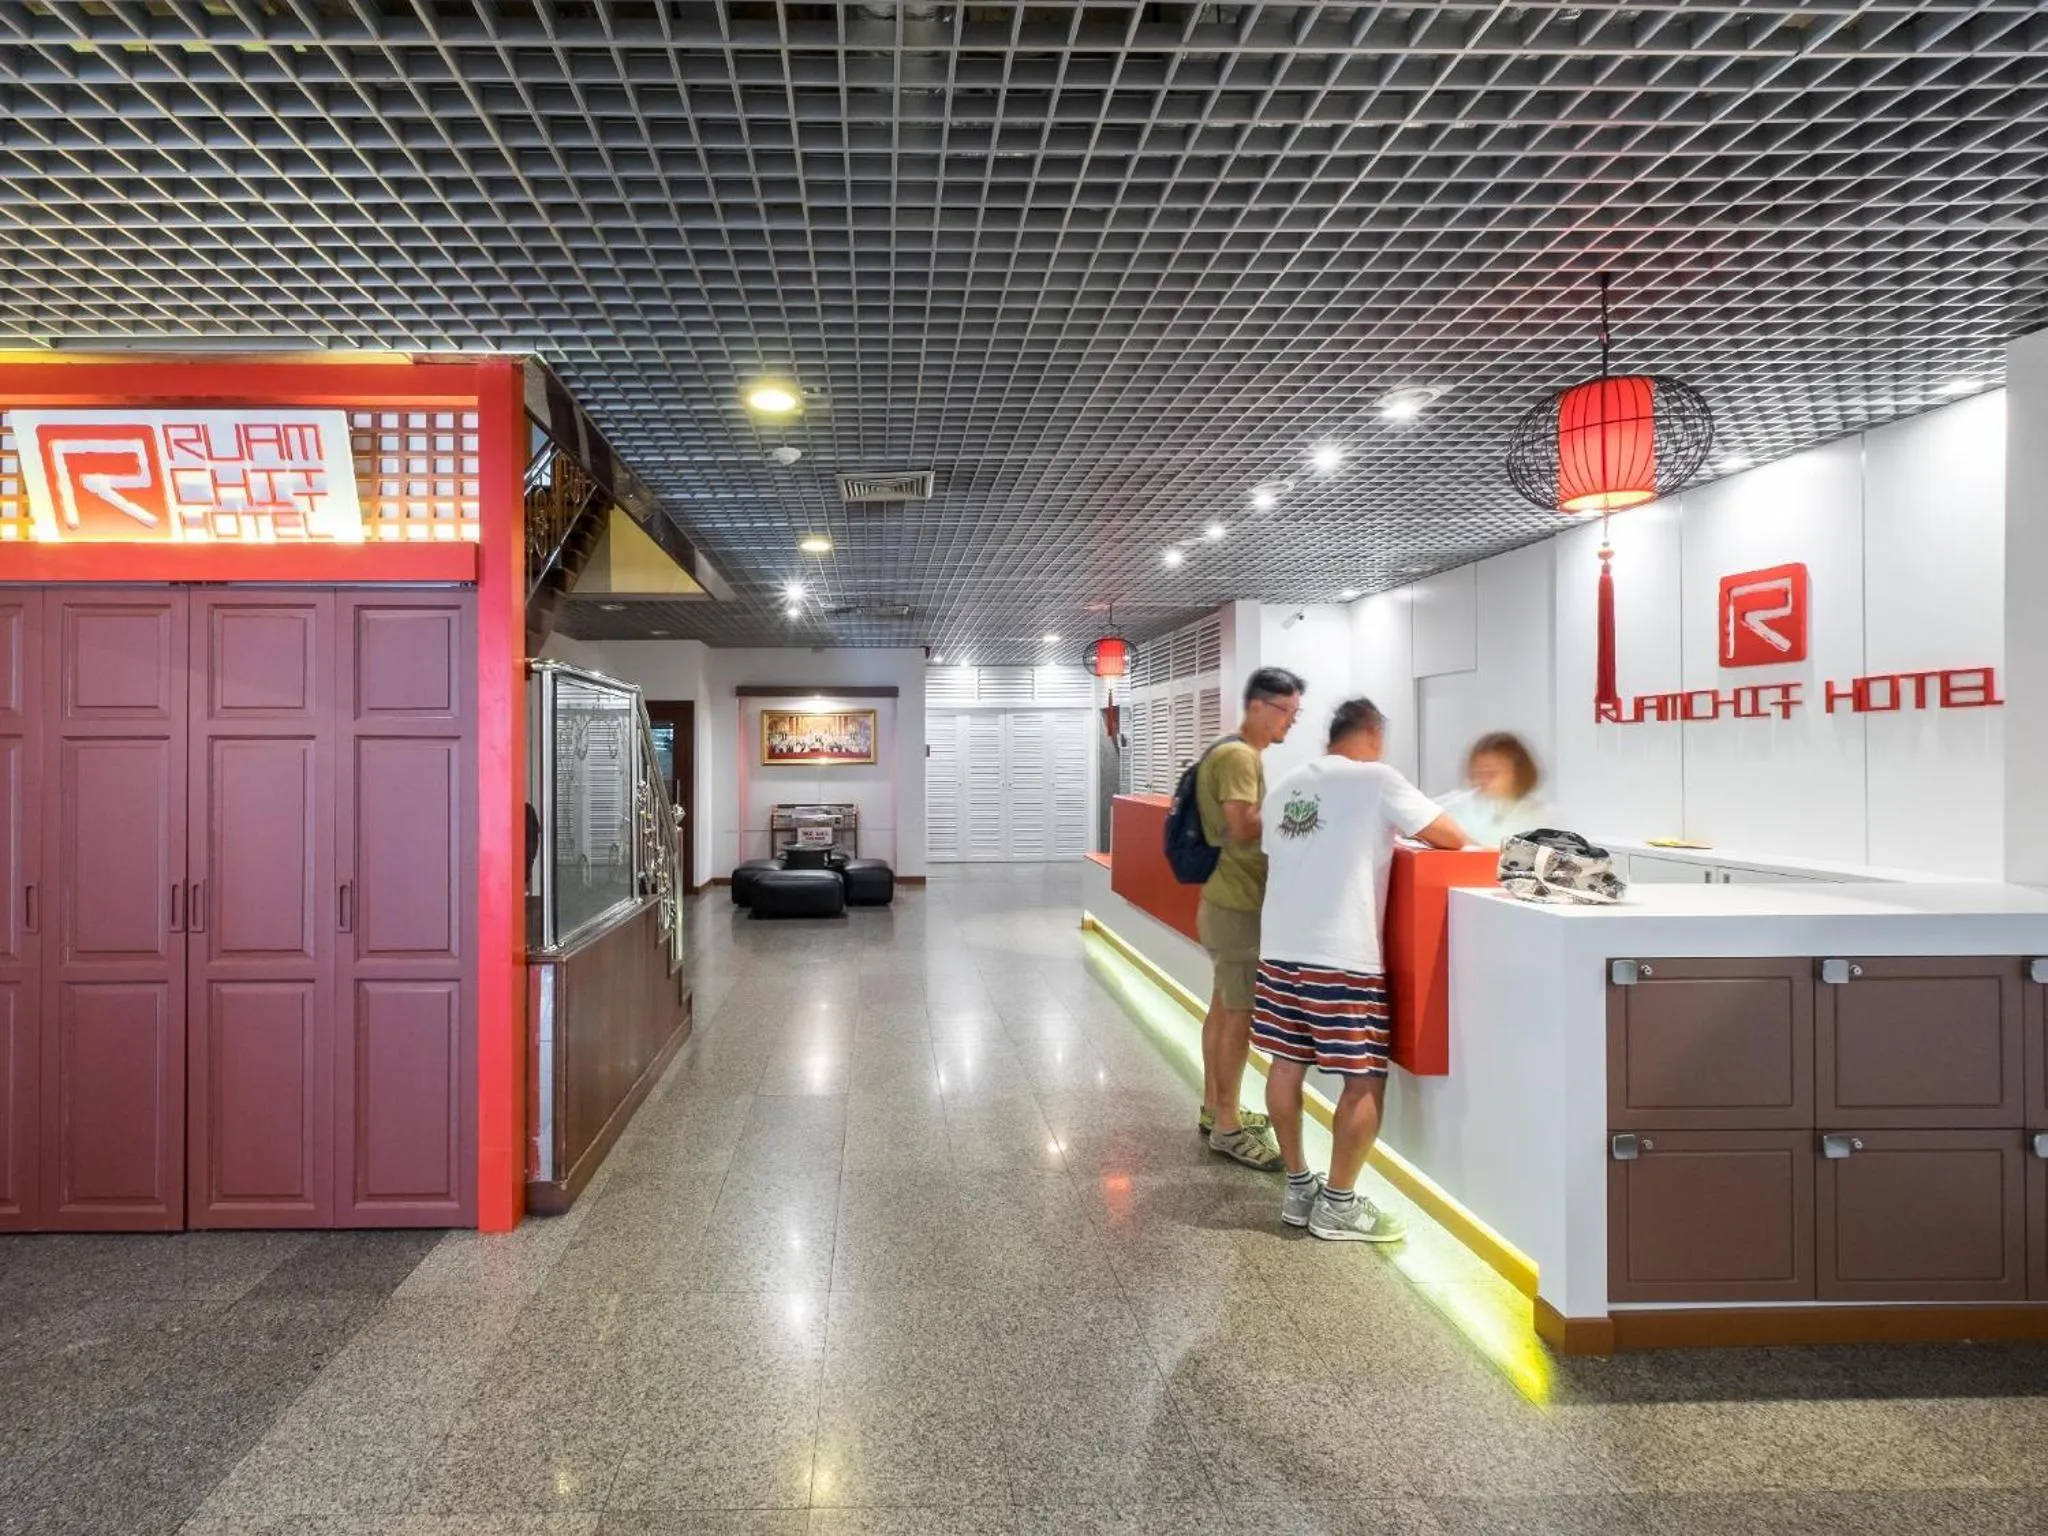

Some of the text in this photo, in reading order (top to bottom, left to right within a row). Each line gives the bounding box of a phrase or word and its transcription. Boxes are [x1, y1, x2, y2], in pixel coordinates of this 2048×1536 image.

[162, 424, 325, 461] RUAM
[49, 438, 159, 530] R
[178, 511, 335, 538] HOTEL
[1726, 575, 1793, 661] R
[1825, 667, 2004, 714] HOTEL
